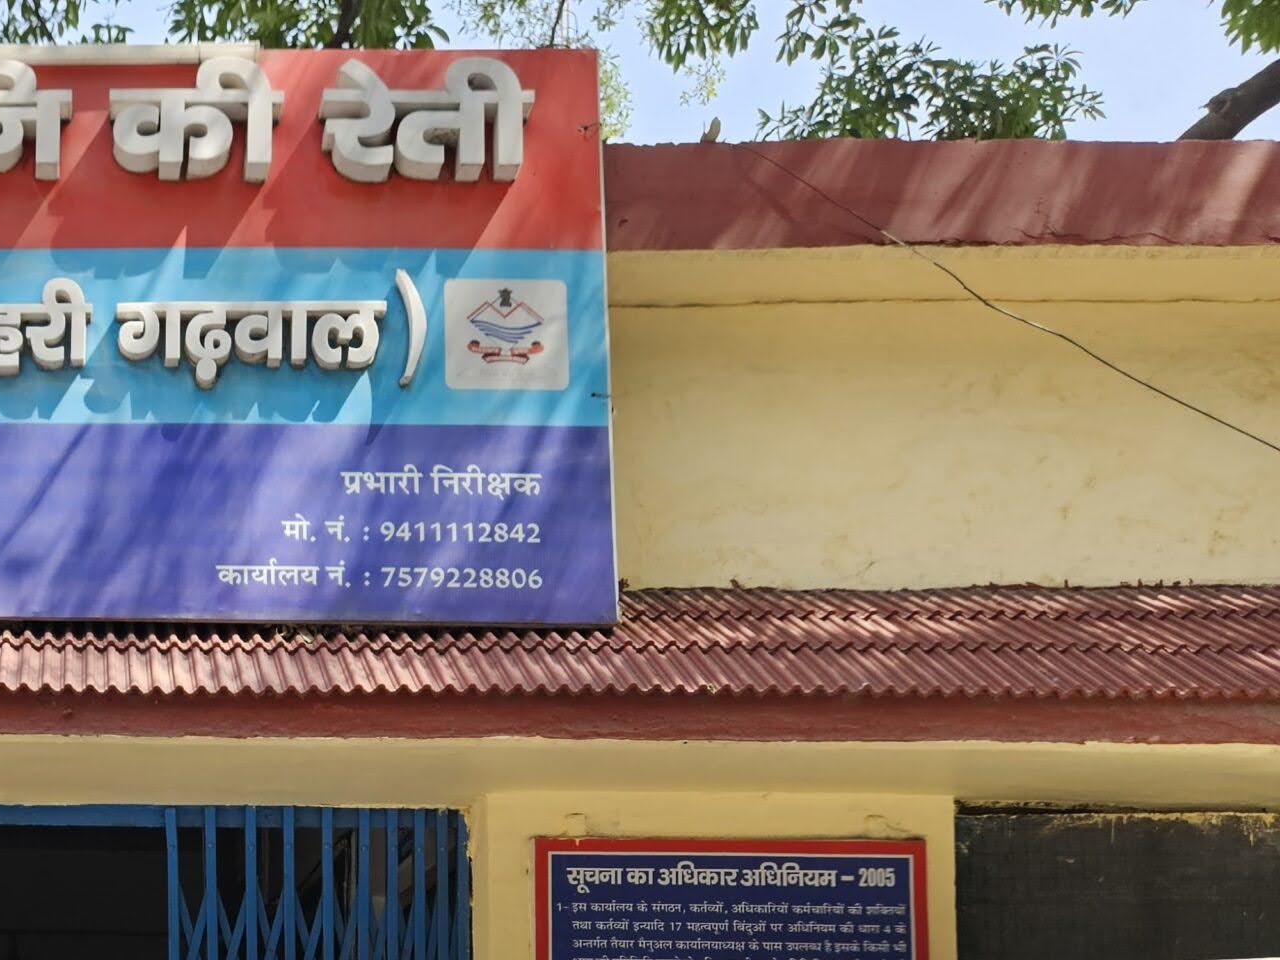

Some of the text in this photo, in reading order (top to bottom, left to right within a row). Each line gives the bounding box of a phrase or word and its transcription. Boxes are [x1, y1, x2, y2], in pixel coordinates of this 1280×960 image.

[110, 52, 285, 184] की
[321, 55, 535, 184] रेती
[341, 464, 542, 500] प्रभारी निरीक्षक
[282, 513, 541, 544] मो. नं. 9411112842
[216, 558, 542, 589] कार्यालय नं. 7579228806
[566, 861, 896, 893] सूचना का अधिकार अधिनियम 2005
[571, 903, 587, 912] इस
[590, 900, 633, 911] कार्यालय
[731, 902, 789, 913] अधिकारियों
[572, 921, 592, 929] तथा
[595, 918, 629, 930] कर्तव्यों
[670, 922, 681, 931] 17
[787, 921, 837, 932] अधिनियम
[610, 937, 635, 948] तैयार
[762, 942, 783, 950] पास
